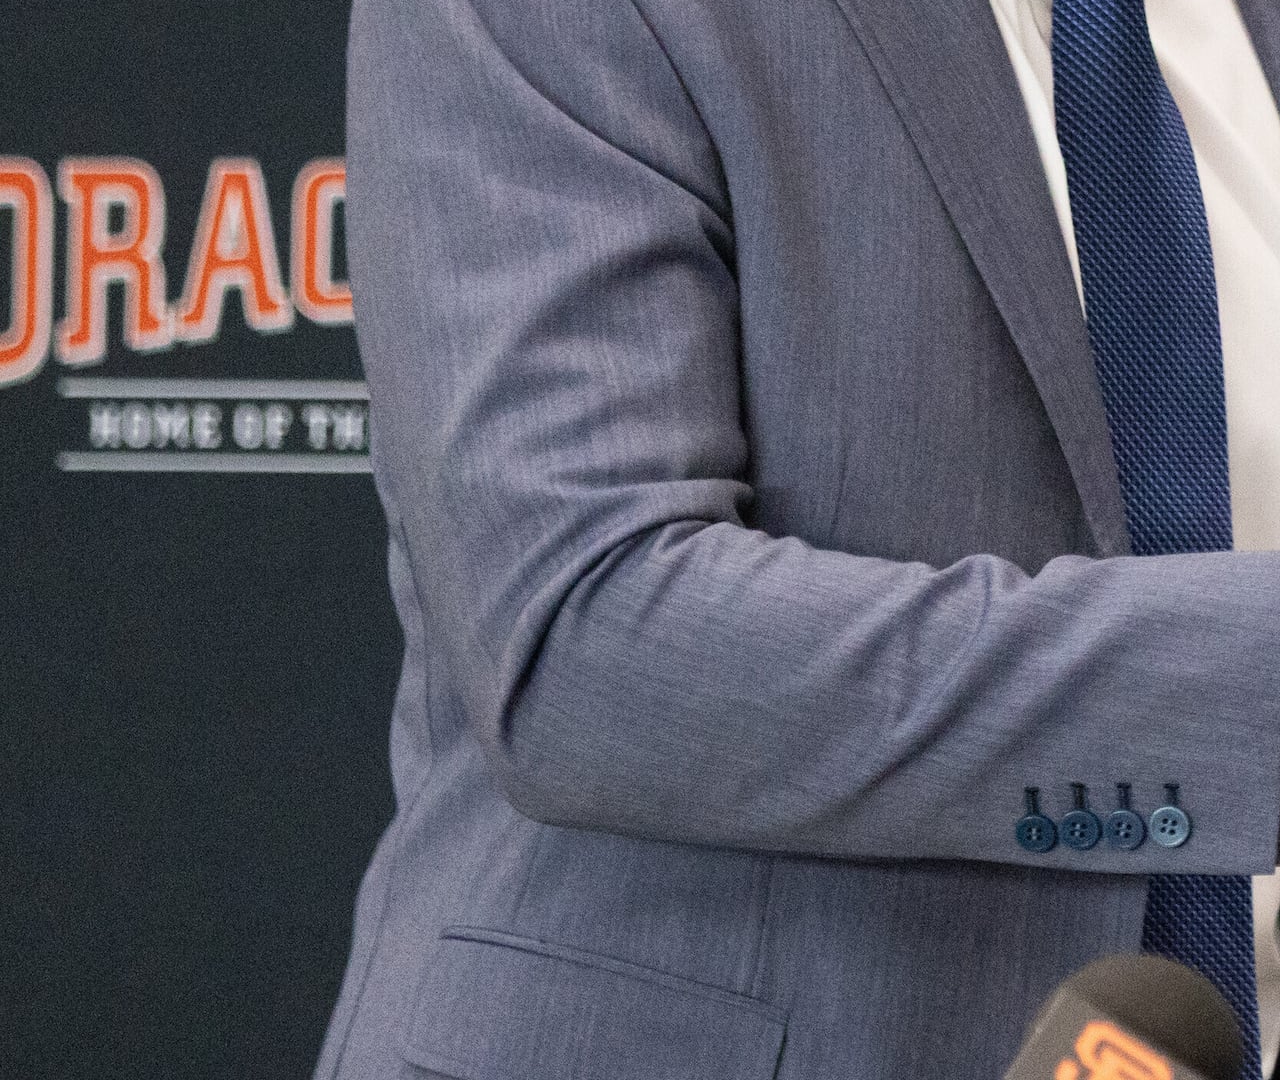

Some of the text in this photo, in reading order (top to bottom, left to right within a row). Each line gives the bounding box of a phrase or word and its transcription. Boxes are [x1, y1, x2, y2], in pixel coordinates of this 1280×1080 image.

[0, 155, 355, 388] ORAC
[89, 402, 365, 451] HOME OF TH
